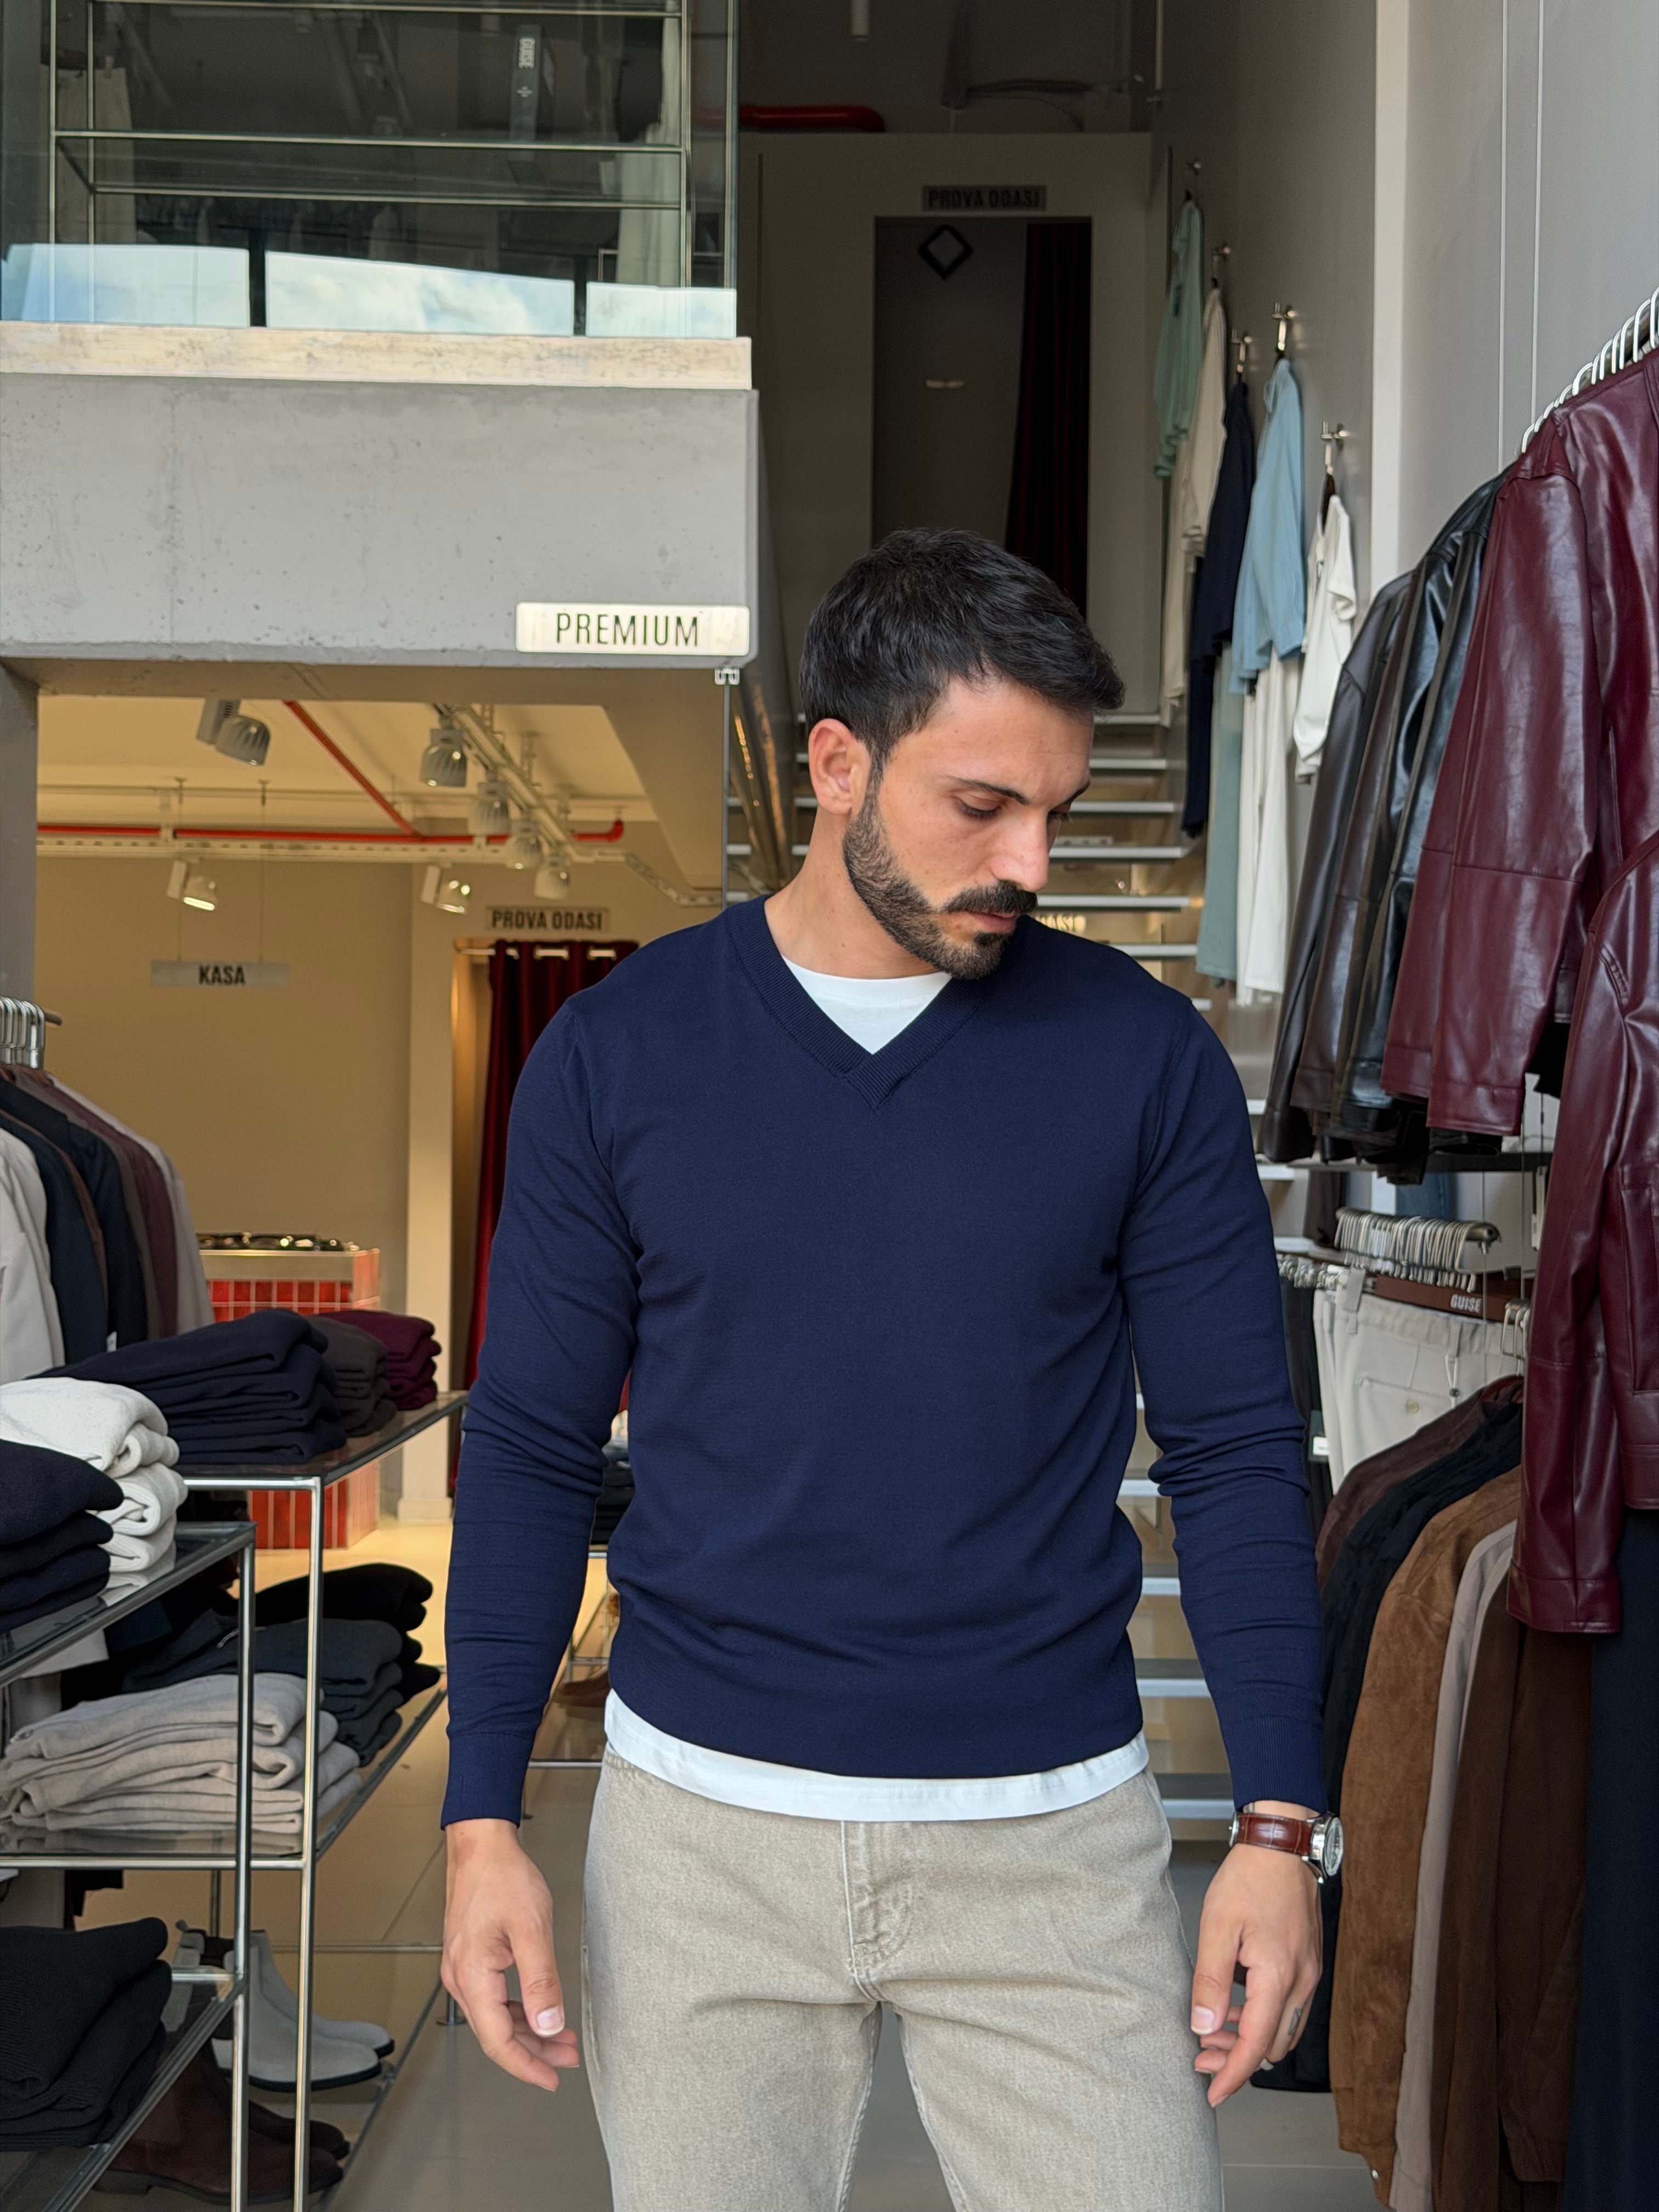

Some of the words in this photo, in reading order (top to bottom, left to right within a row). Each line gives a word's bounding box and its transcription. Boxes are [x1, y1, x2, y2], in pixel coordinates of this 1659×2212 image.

[928, 190, 983, 208] PROVA
[556, 613, 697, 647] PREMIUM
[492, 909, 547, 929] PROVA
[552, 911, 602, 930] ODASI
[199, 965, 245, 985] KASA
[1451, 1294, 1482, 1313] GUISE
